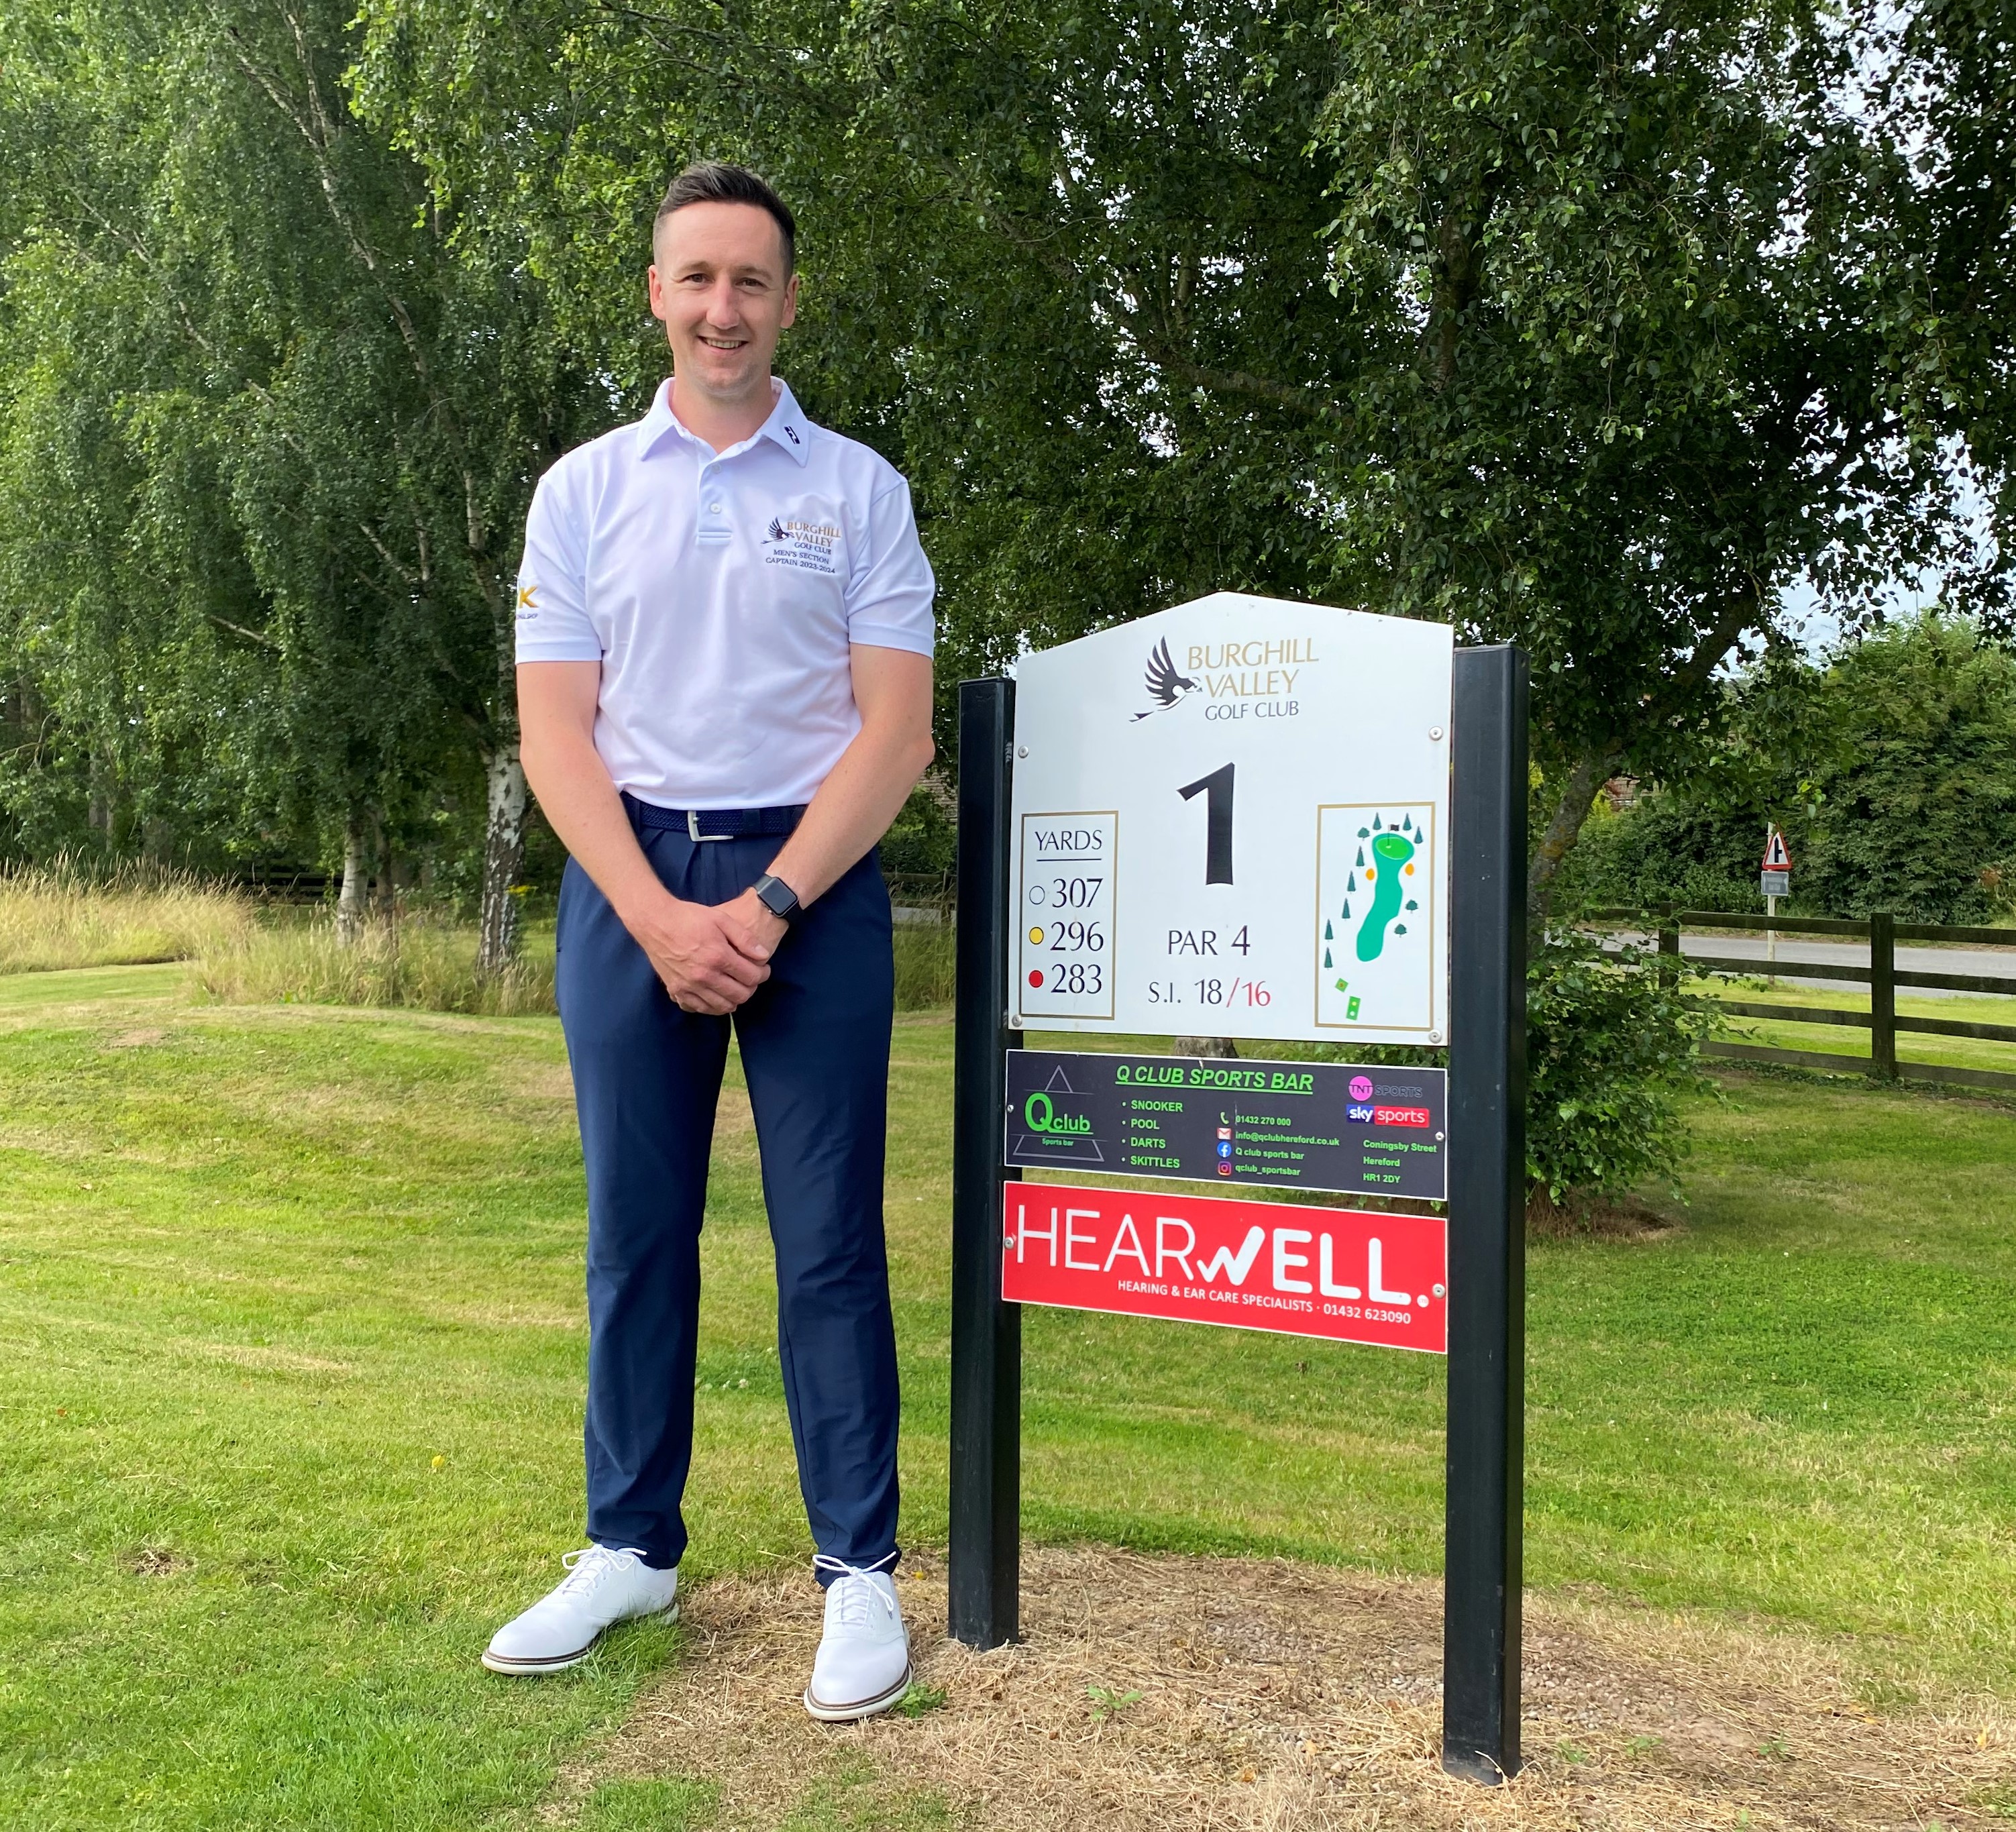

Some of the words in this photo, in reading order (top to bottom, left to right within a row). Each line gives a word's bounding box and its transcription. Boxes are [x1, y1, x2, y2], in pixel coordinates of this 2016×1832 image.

[787, 521, 841, 537] BURGHILL
[795, 532, 833, 547] VALLEY
[794, 541, 812, 550] GOLF
[814, 546, 832, 555] CLUB
[765, 557, 798, 565] CAPTAIN
[800, 561, 835, 574] 2023-2024
[799, 552, 829, 564] SECTION
[1187, 638, 1319, 670] BURGHILL
[1205, 669, 1300, 698] VALLEY
[1205, 703, 1249, 720] GOLF
[1255, 701, 1299, 718] CLUB
[1177, 761, 1234, 885] 1
[1034, 830, 1102, 851] YARDS
[1052, 878, 1104, 908] 307
[1050, 922, 1104, 951] 296
[1168, 930, 1218, 955] PAR
[1230, 925, 1251, 956] 4
[1051, 964, 1102, 994] 283
[1148, 981, 1181, 1004] S.I.
[1116, 1065, 1130, 1082] Q
[1134, 1066, 1184, 1084] CLUB
[1189, 1068, 1265, 1088] SPORTS
[1270, 1073, 1314, 1091] BAR
[1349, 1084, 1373, 1094] TNT
[1375, 1085, 1422, 1097] SPORTS
[1131, 1099, 1183, 1112] SNOOKER
[1236, 1115, 1259, 1124] 01432
[1261, 1116, 1275, 1125] 270
[1277, 1118, 1291, 1126] 000
[1349, 1106, 1373, 1122] sky
[1377, 1110, 1425, 1124] sports
[1130, 1118, 1160, 1130] POOL
[1042, 1138, 1062, 1146] Sports
[1130, 1137, 1166, 1149] DARTS
[1236, 1131, 1340, 1146] info@qclubhereford.co.uk
[1363, 1140, 1409, 1152] Coningsby
[1411, 1142, 1437, 1152] Street
[1236, 1148, 1242, 1156] Q
[1244, 1148, 1261, 1156] club
[1263, 1151, 1289, 1159] sports
[1291, 1151, 1304, 1160] bar
[1363, 1156, 1400, 1167] Hereford
[1130, 1156, 1180, 1169] SKITTLES
[1235, 1165, 1301, 1176] qclub_sportsbar
[1363, 1173, 1380, 1181] HR1
[1383, 1175, 1401, 1183] 2DY
[1118, 1280, 1168, 1295] HEARING
[1171, 1285, 1180, 1297] &
[1183, 1287, 1206, 1299] EAR
[1209, 1290, 1239, 1304] CARE
[1242, 1293, 1313, 1312] SPECIALISTS
[1323, 1303, 1361, 1318] 01432
[1365, 1308, 1411, 1324] 623090
